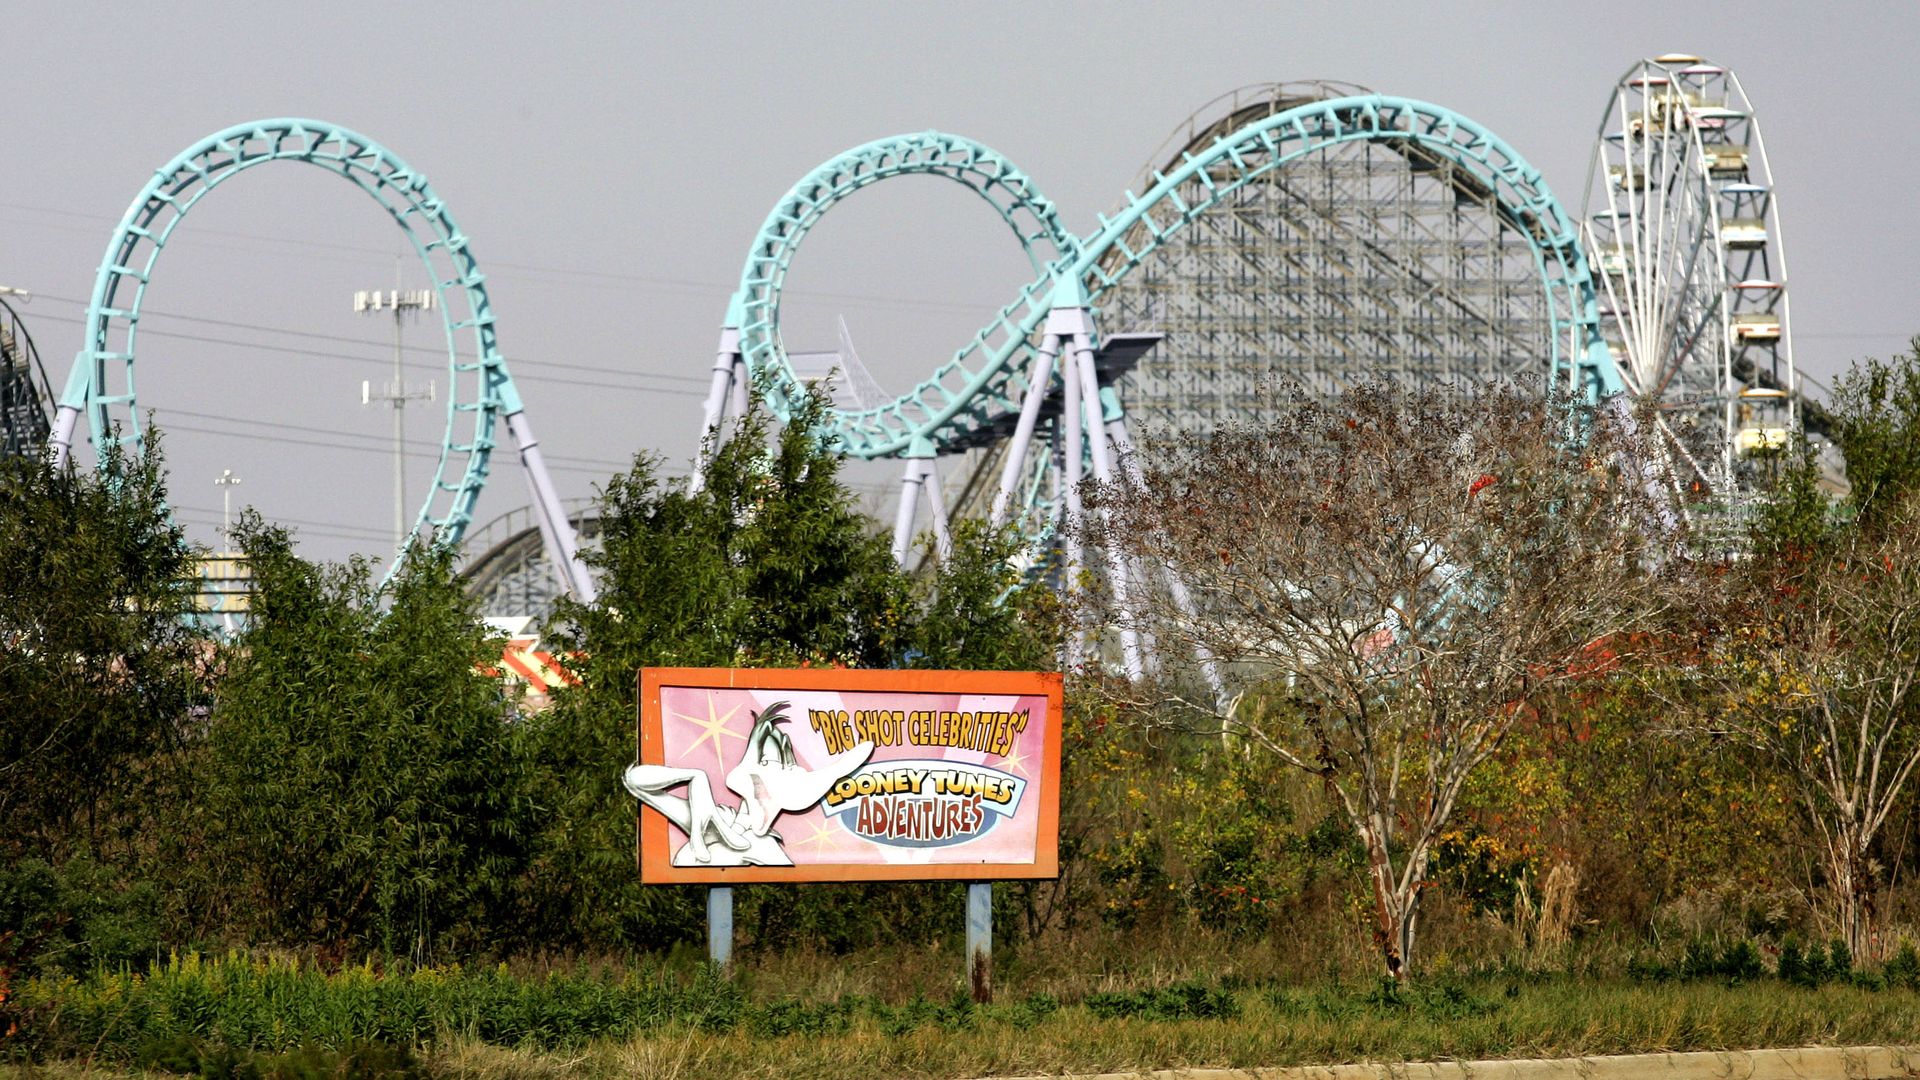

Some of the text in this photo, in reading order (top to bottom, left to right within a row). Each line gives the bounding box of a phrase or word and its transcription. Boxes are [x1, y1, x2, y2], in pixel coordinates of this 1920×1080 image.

[809, 708, 1030, 757] "BIG SHOT CELEBRITIES"
[930, 769, 1016, 804] TUNES
[857, 794, 985, 841] ADVENTURES
